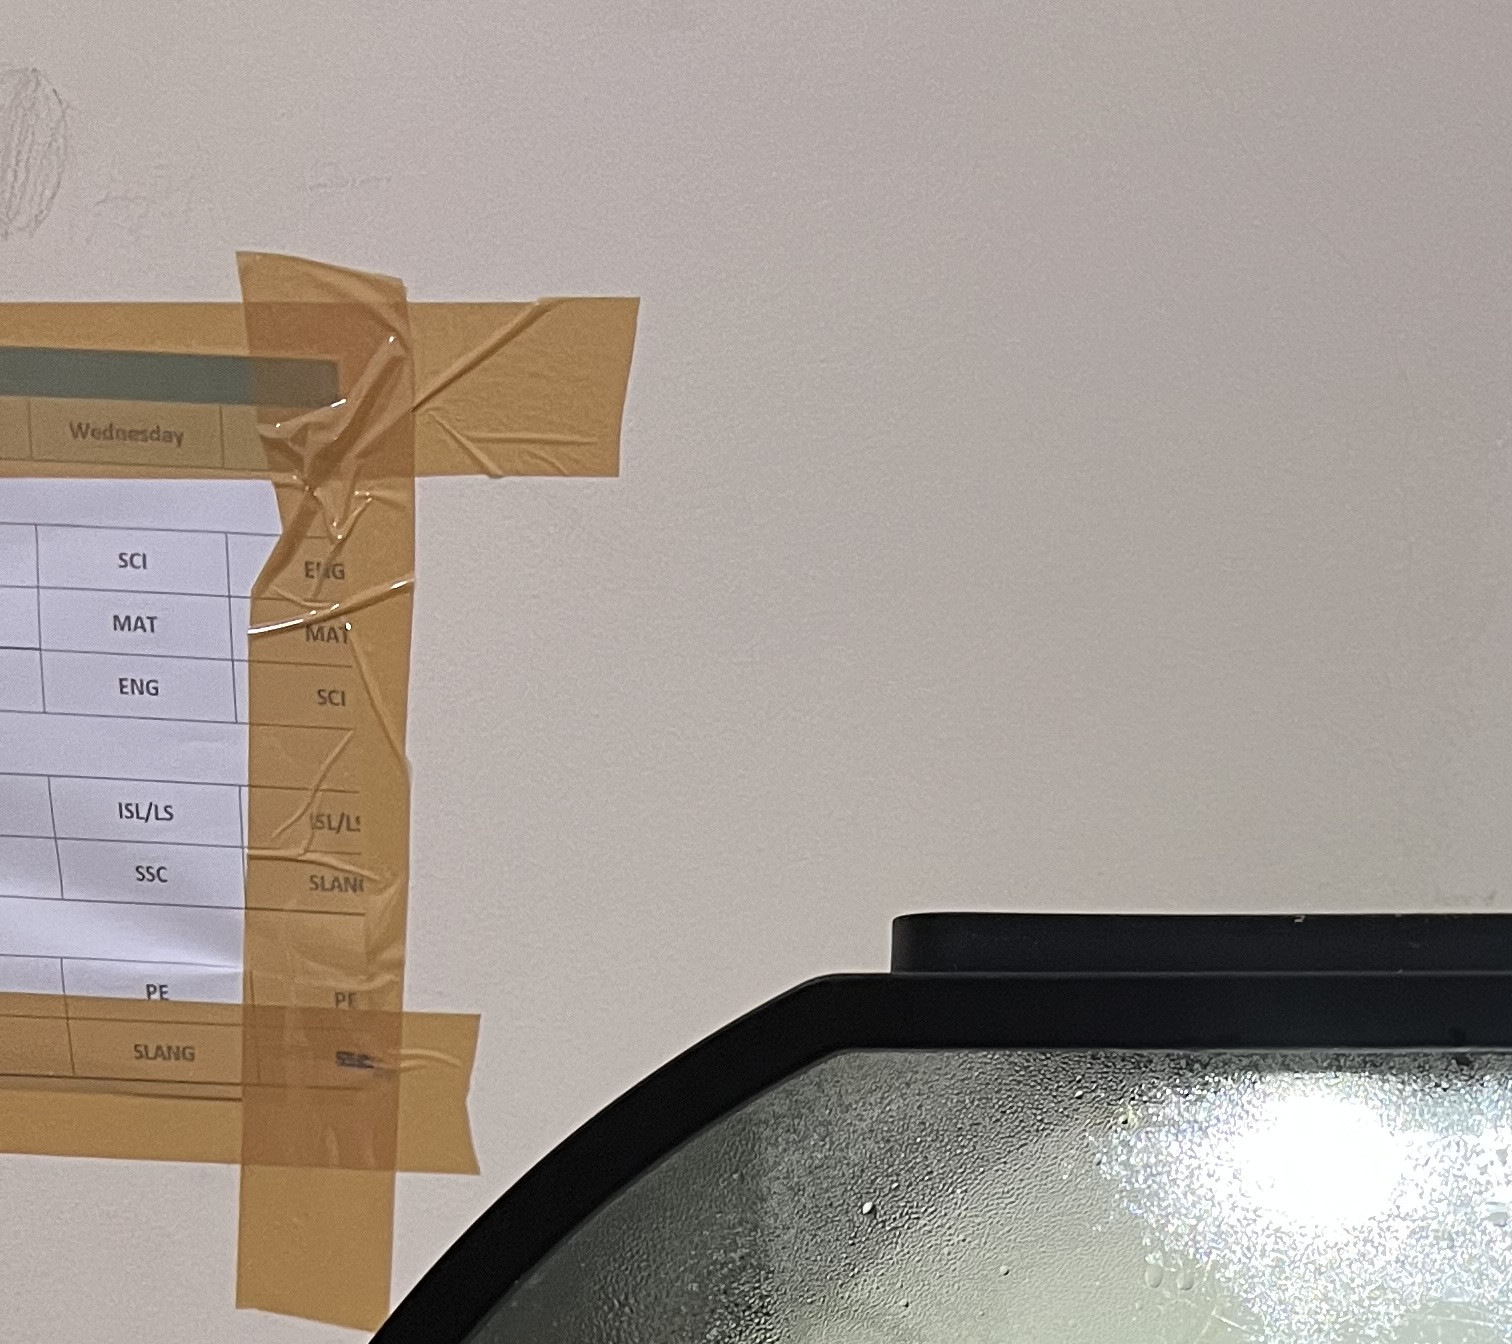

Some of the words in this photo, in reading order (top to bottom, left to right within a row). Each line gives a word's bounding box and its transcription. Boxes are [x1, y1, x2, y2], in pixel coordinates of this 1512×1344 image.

[69, 421, 184, 448] Wednesday
[118, 552, 147, 569] SCI
[113, 614, 158, 633] MAT
[118, 677, 159, 696] ENG
[317, 689, 346, 706] SCI
[118, 801, 174, 823] ISL/LS
[135, 865, 168, 882] SSC
[146, 983, 169, 1000] PE
[134, 1043, 195, 1061] SLANG
